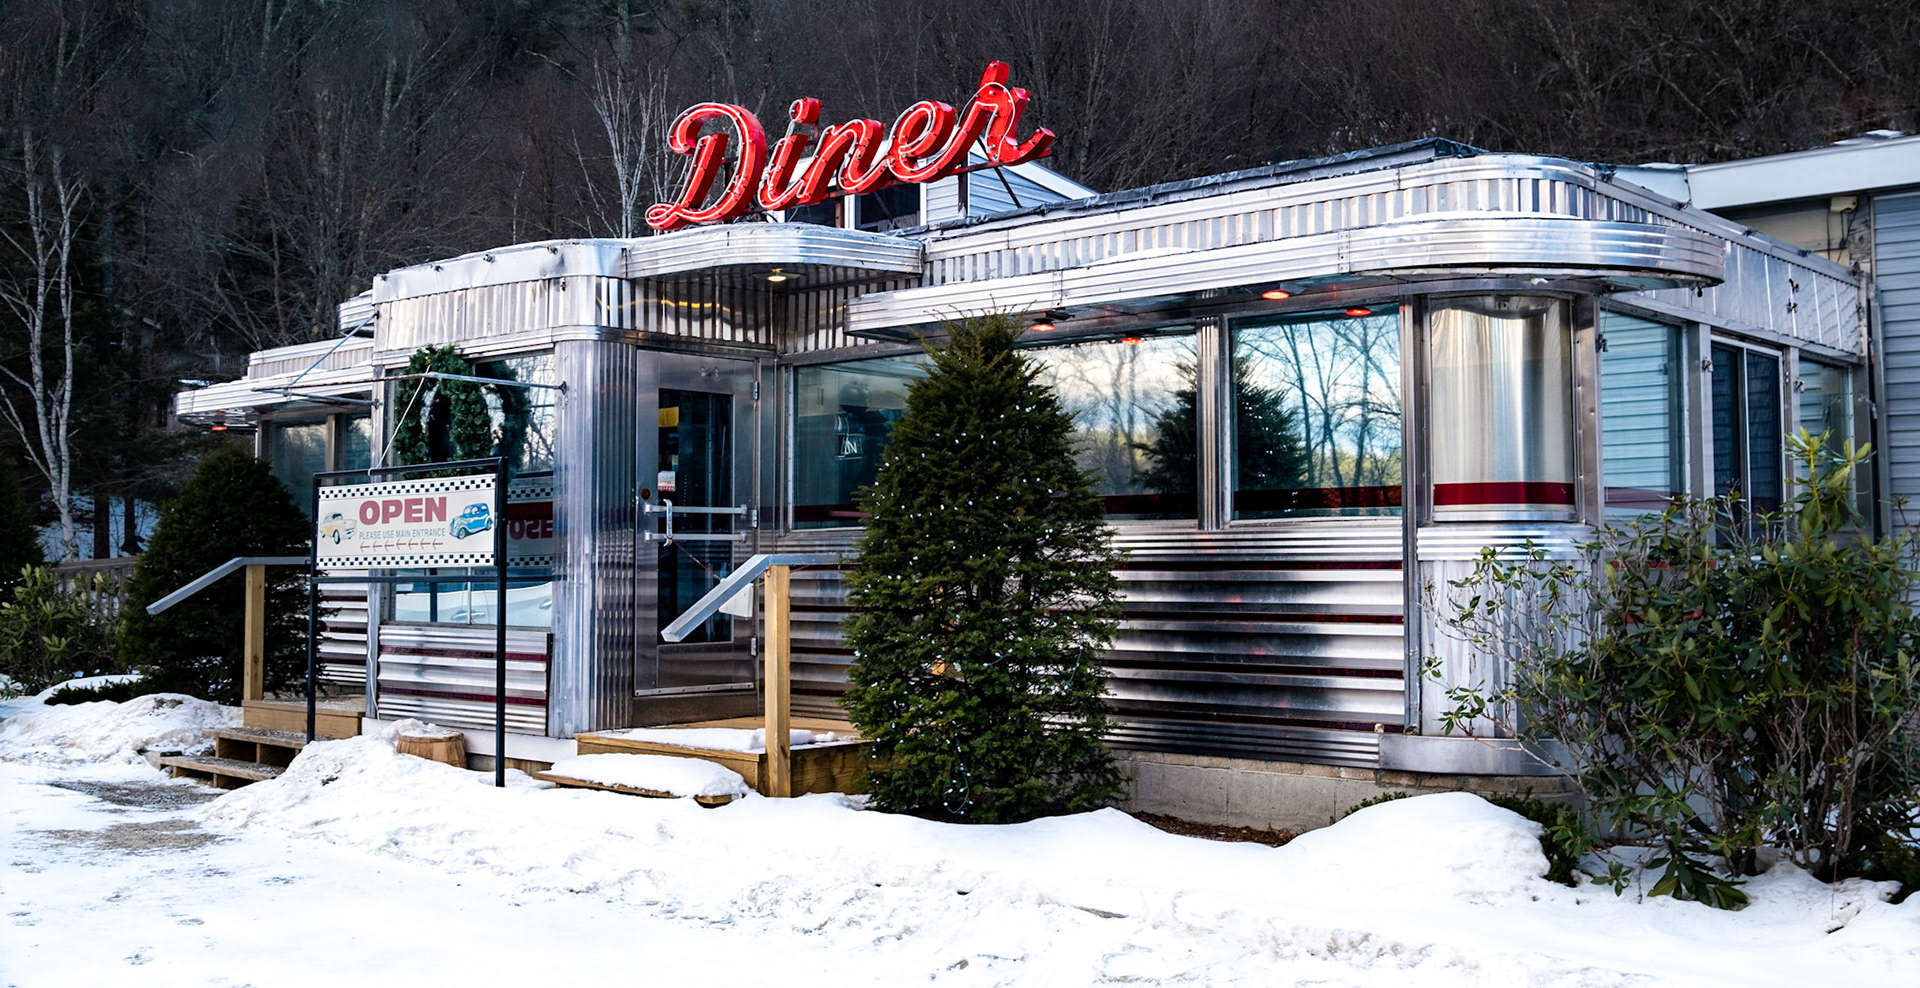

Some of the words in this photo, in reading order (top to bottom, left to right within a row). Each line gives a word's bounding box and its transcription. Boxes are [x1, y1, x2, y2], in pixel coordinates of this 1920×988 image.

[645, 61, 1055, 230] Diner
[359, 496, 447, 526] OPEN
[359, 530, 382, 540] PLEASE
[383, 529, 395, 539] USE
[396, 528, 411, 538] MAIN
[412, 527, 446, 538] ENTRANCE
